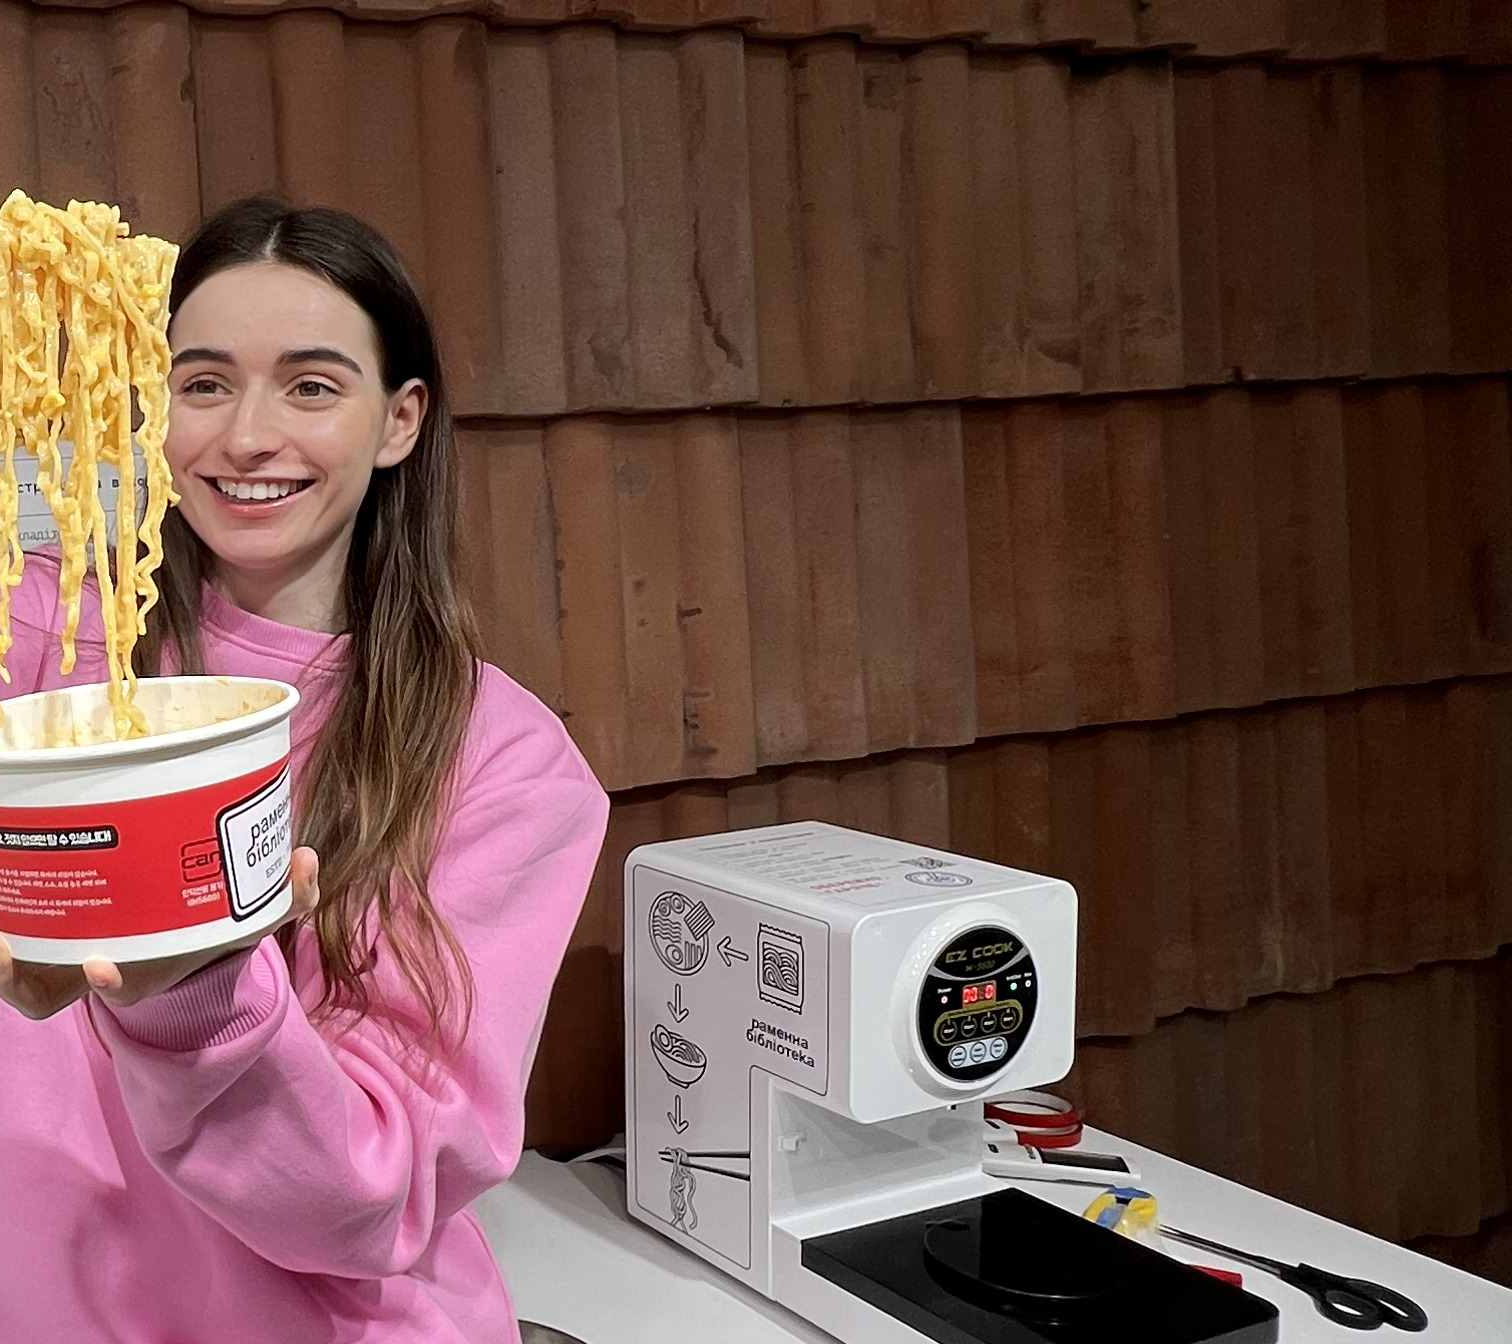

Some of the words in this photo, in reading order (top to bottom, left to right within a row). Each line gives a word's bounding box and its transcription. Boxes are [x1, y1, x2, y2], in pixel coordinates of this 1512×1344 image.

[972, 941, 1014, 959] COOK
[746, 1029, 815, 1067] бібліотека
[752, 1018, 809, 1049] раменна
